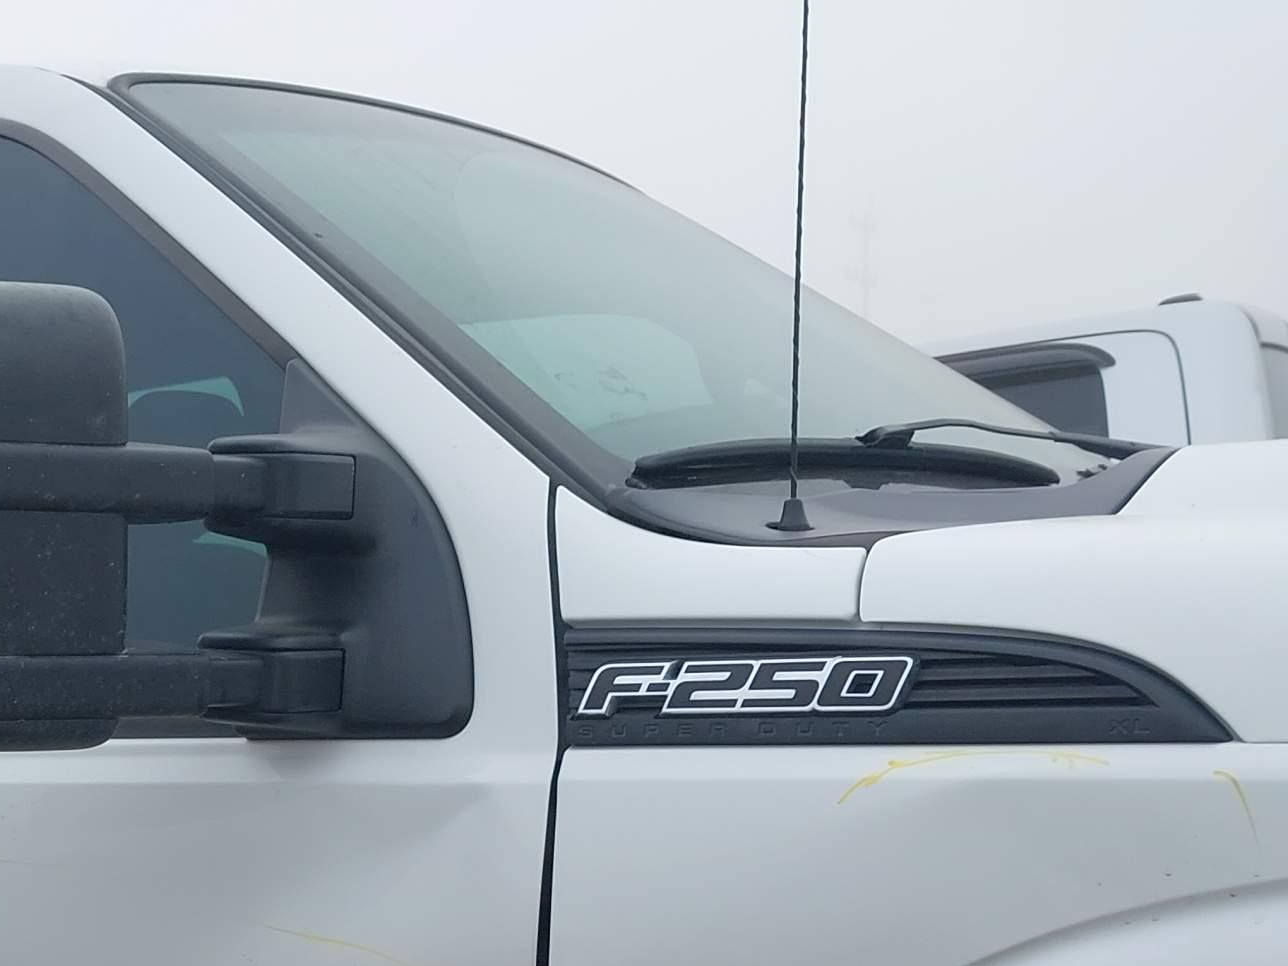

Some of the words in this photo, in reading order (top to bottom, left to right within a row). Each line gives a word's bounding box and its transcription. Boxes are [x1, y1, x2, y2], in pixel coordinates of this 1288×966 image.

[577, 655, 916, 716] F-250
[577, 721, 728, 740] SUPER
[758, 719, 890, 738] DUTY
[1108, 717, 1152, 735] XL
